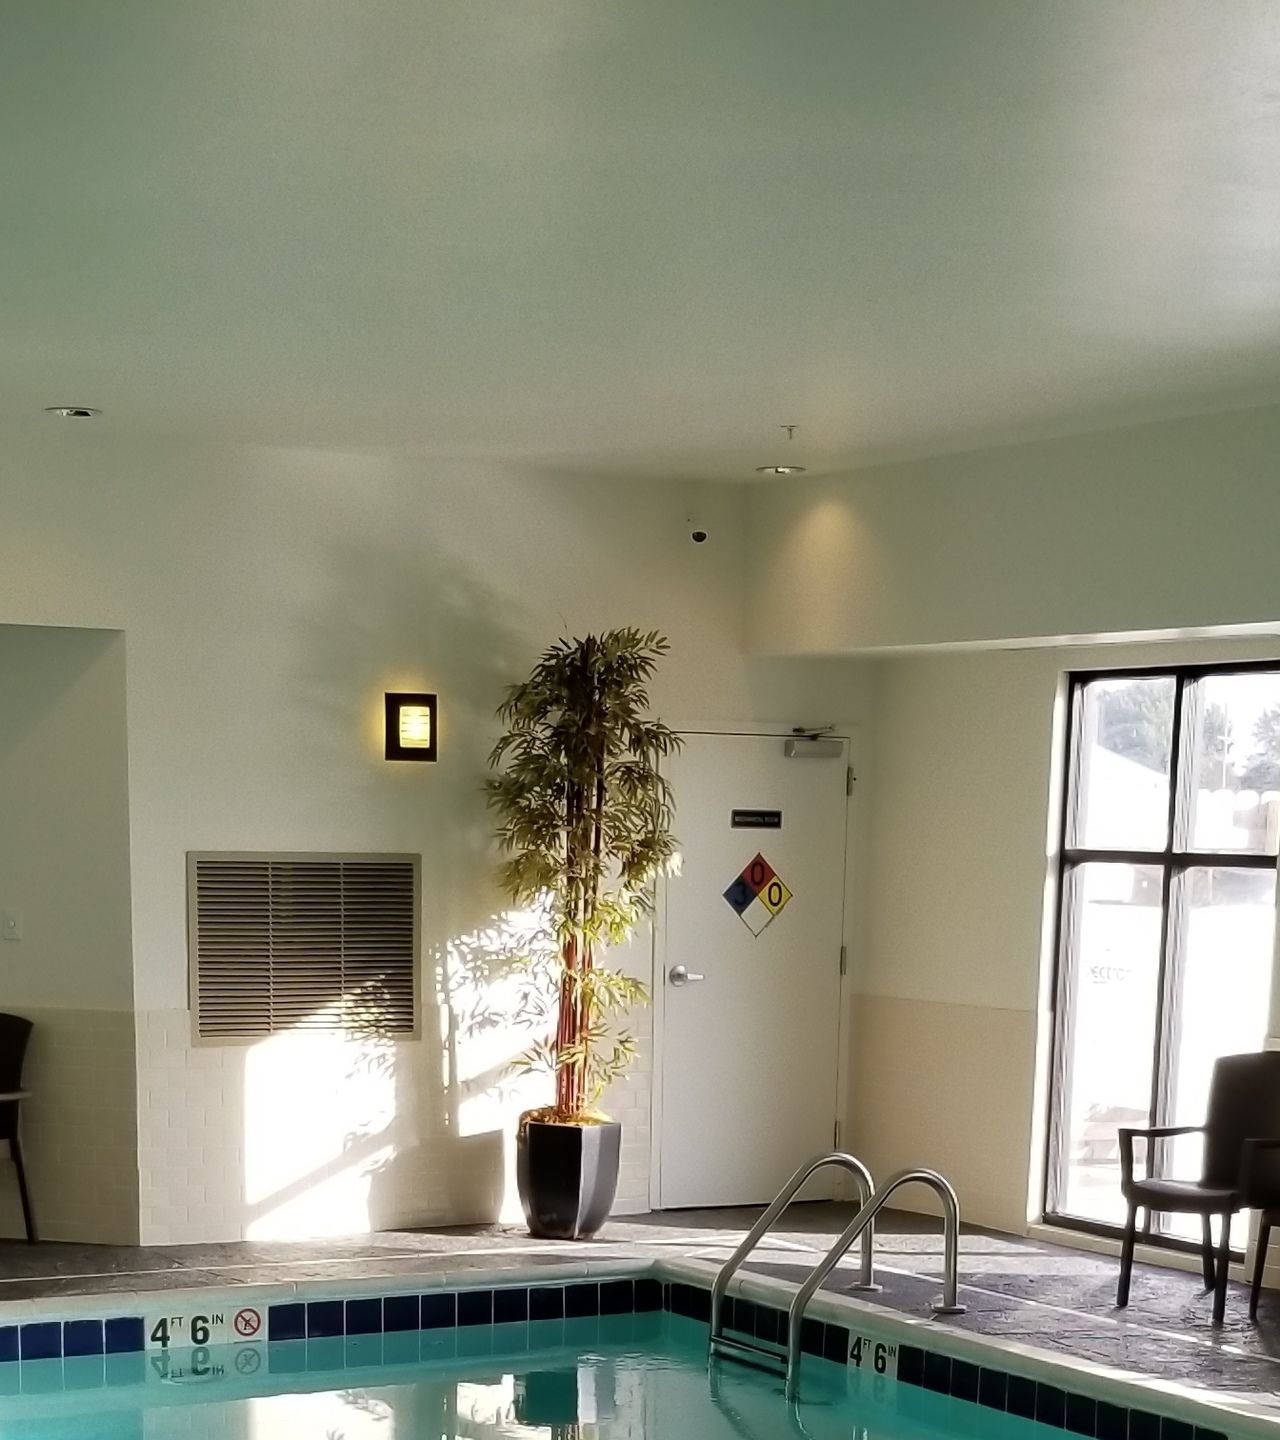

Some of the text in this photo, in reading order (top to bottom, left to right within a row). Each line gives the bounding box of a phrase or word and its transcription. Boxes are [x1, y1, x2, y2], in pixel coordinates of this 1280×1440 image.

[750, 862, 764, 886] 0
[767, 882, 782, 907] 0
[150, 1313, 224, 1348] 4 FT 6 IN
[850, 1336, 896, 1374] 4 FT 6 IN
